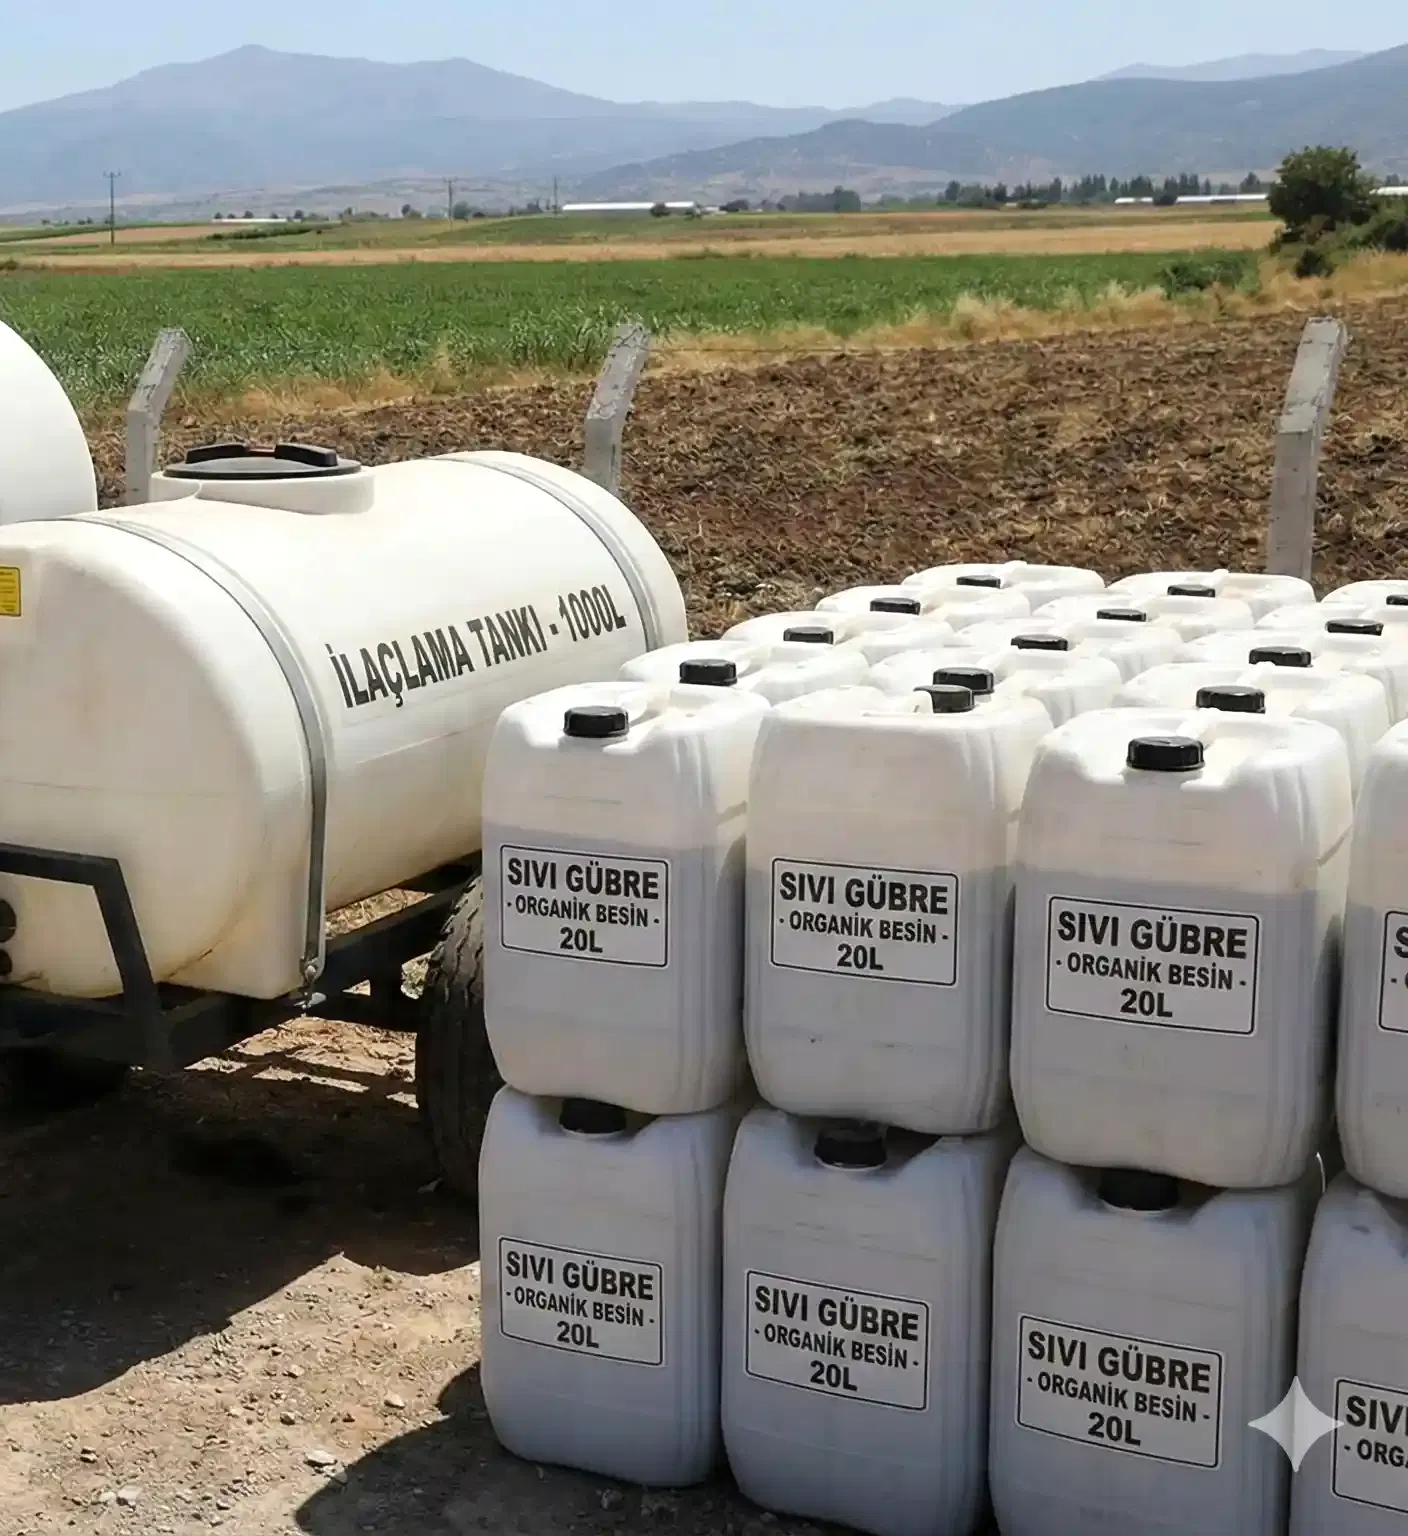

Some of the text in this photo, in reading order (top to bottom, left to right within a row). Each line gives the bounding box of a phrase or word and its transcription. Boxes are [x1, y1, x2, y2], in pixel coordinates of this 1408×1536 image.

[324, 625, 476, 708] İLAÇLAMA
[466, 604, 548, 668] TANKI
[556, 584, 627, 642] 1000L
[507, 857, 659, 900] SIVI GÜBRE
[779, 871, 948, 915] SIVI GÜBRE
[515, 894, 591, 922] ORGANİK
[596, 903, 649, 928] BESİN
[789, 910, 874, 939] ORGANİK
[879, 918, 936, 944] BESİN
[559, 926, 604, 954] 20L
[1057, 910, 1248, 960] SIVI GÜBRE
[836, 943, 884, 971] 20L
[1067, 952, 1162, 984] ORGANİK
[1168, 962, 1233, 990] BESİN
[1120, 987, 1173, 1018] 20L
[505, 1250, 654, 1301] SIVI GÜBRE
[514, 1286, 589, 1318] ORGANİK
[592, 1302, 645, 1327] BESİN
[754, 1285, 920, 1342] SIVI GÜBRE
[557, 1320, 600, 1349] 20L
[764, 1323, 846, 1359] ORGANİK
[851, 1341, 908, 1370] BESİN
[810, 1359, 859, 1392] 20L
[1027, 1331, 1211, 1394] SIVI GÜBRE
[1037, 1371, 1128, 1410] ORGANİK
[1134, 1391, 1197, 1423] BESİN
[1087, 1411, 1142, 1446] 20L
